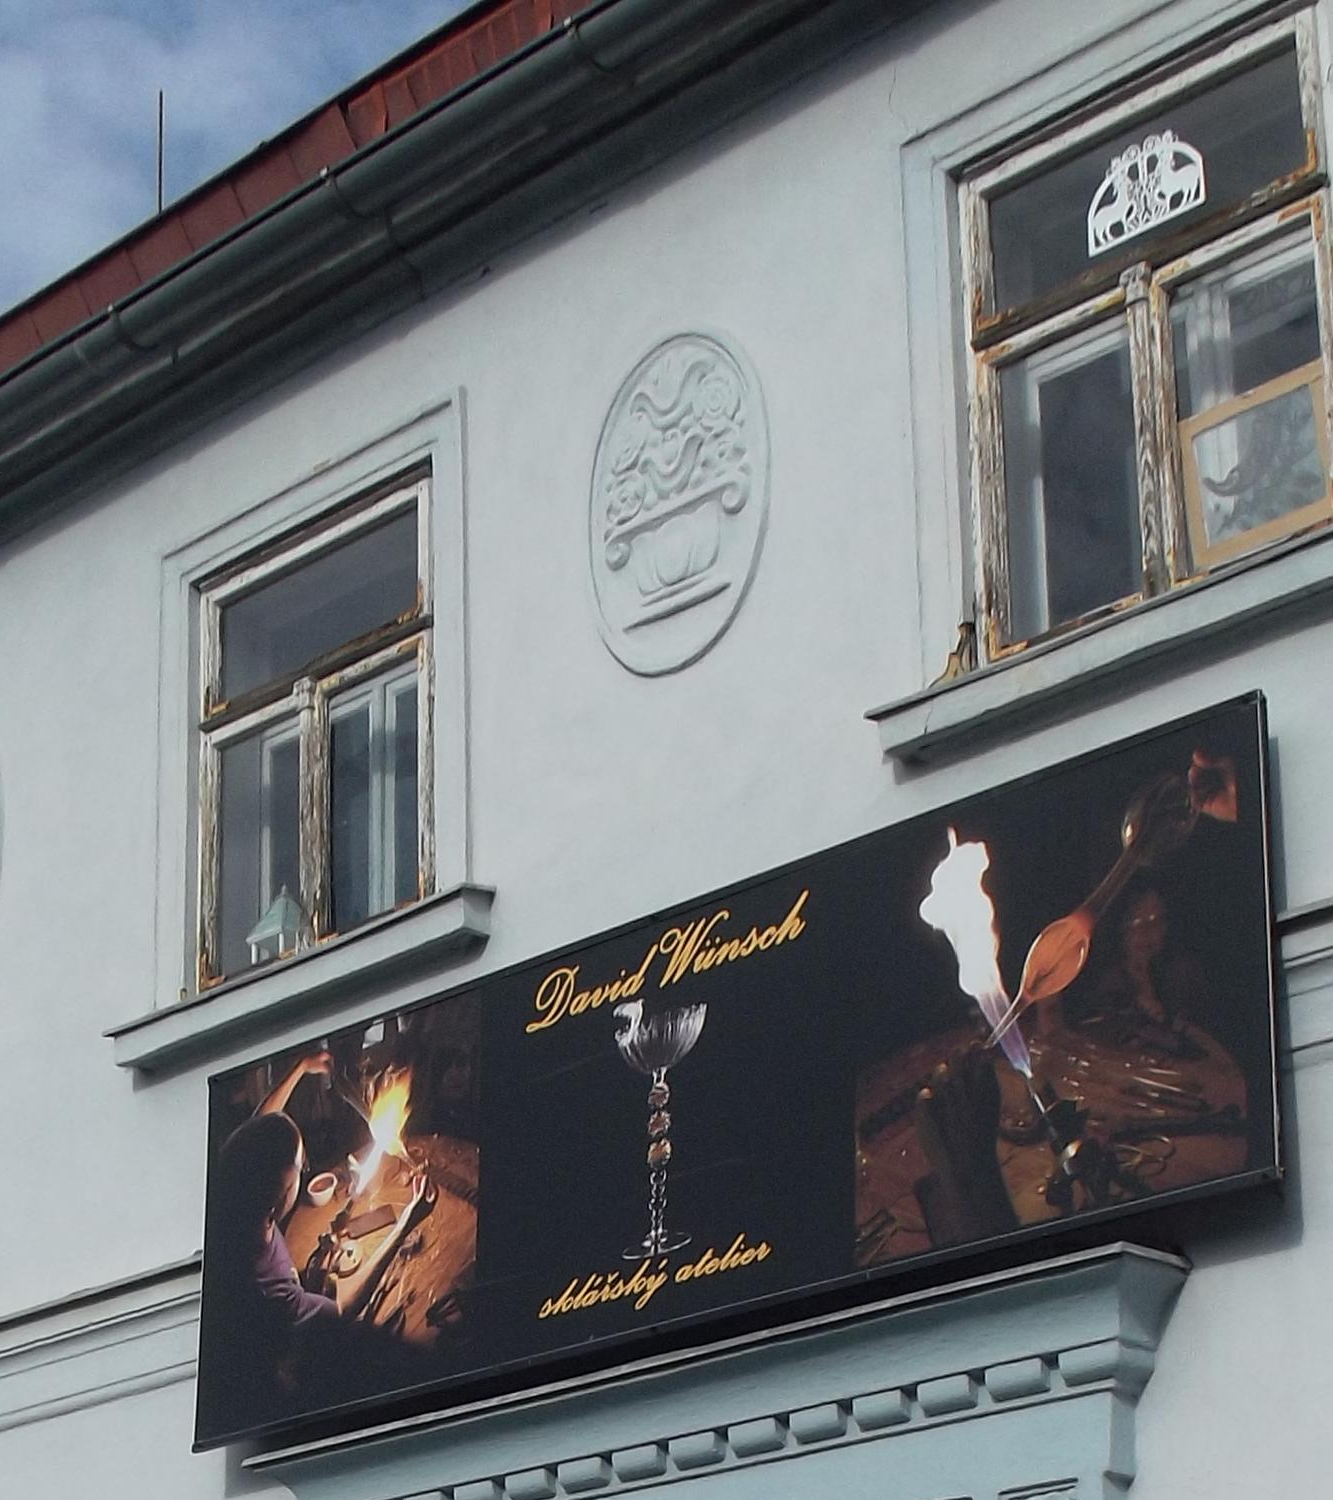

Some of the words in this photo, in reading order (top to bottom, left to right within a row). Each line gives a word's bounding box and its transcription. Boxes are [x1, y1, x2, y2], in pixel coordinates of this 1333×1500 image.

[525, 943, 659, 1034] David
[659, 888, 810, 988] Wünsch
[538, 1257, 670, 1319] sklářský
[673, 1232, 772, 1284] atelier
